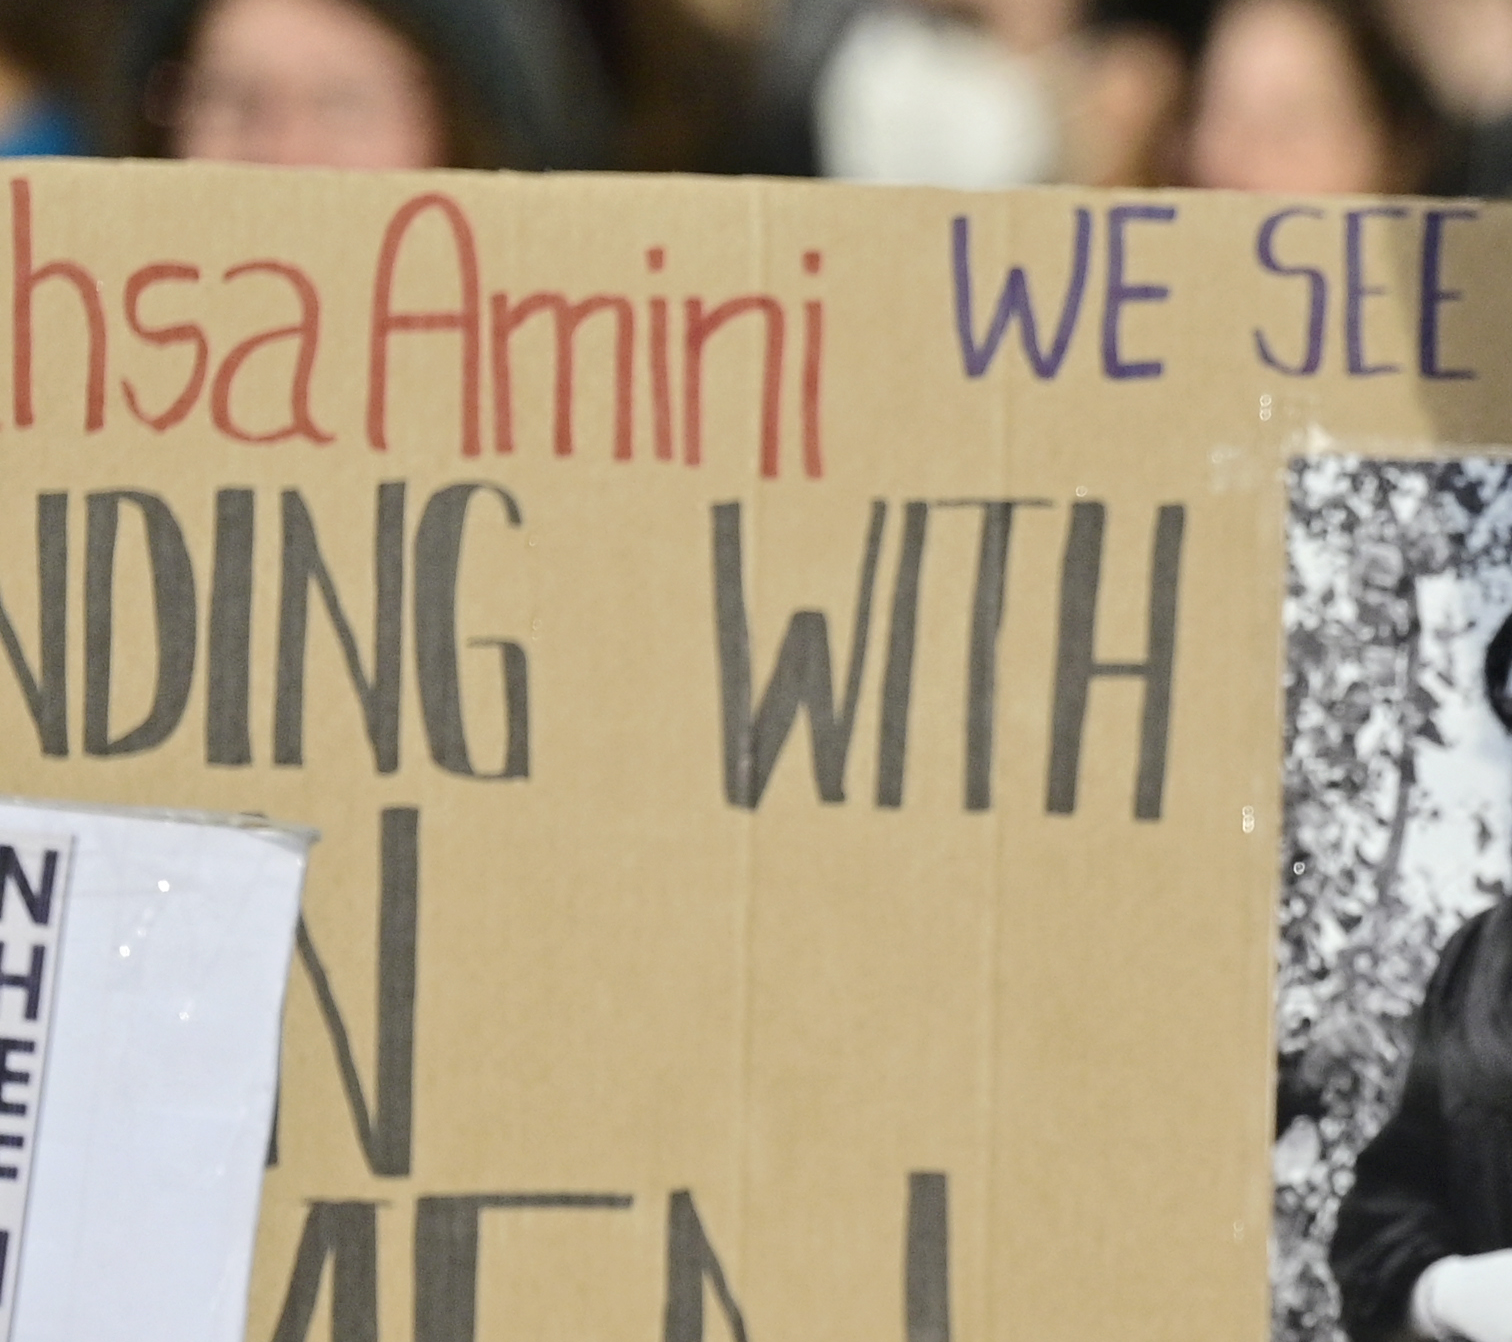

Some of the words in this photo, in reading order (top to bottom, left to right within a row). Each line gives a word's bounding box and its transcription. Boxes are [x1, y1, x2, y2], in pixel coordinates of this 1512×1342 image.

[0, 178, 825, 479] hsaAmini
[954, 205, 1177, 379] WE
[1254, 208, 1479, 379] SEE
[709, 498, 1187, 822] WITH
